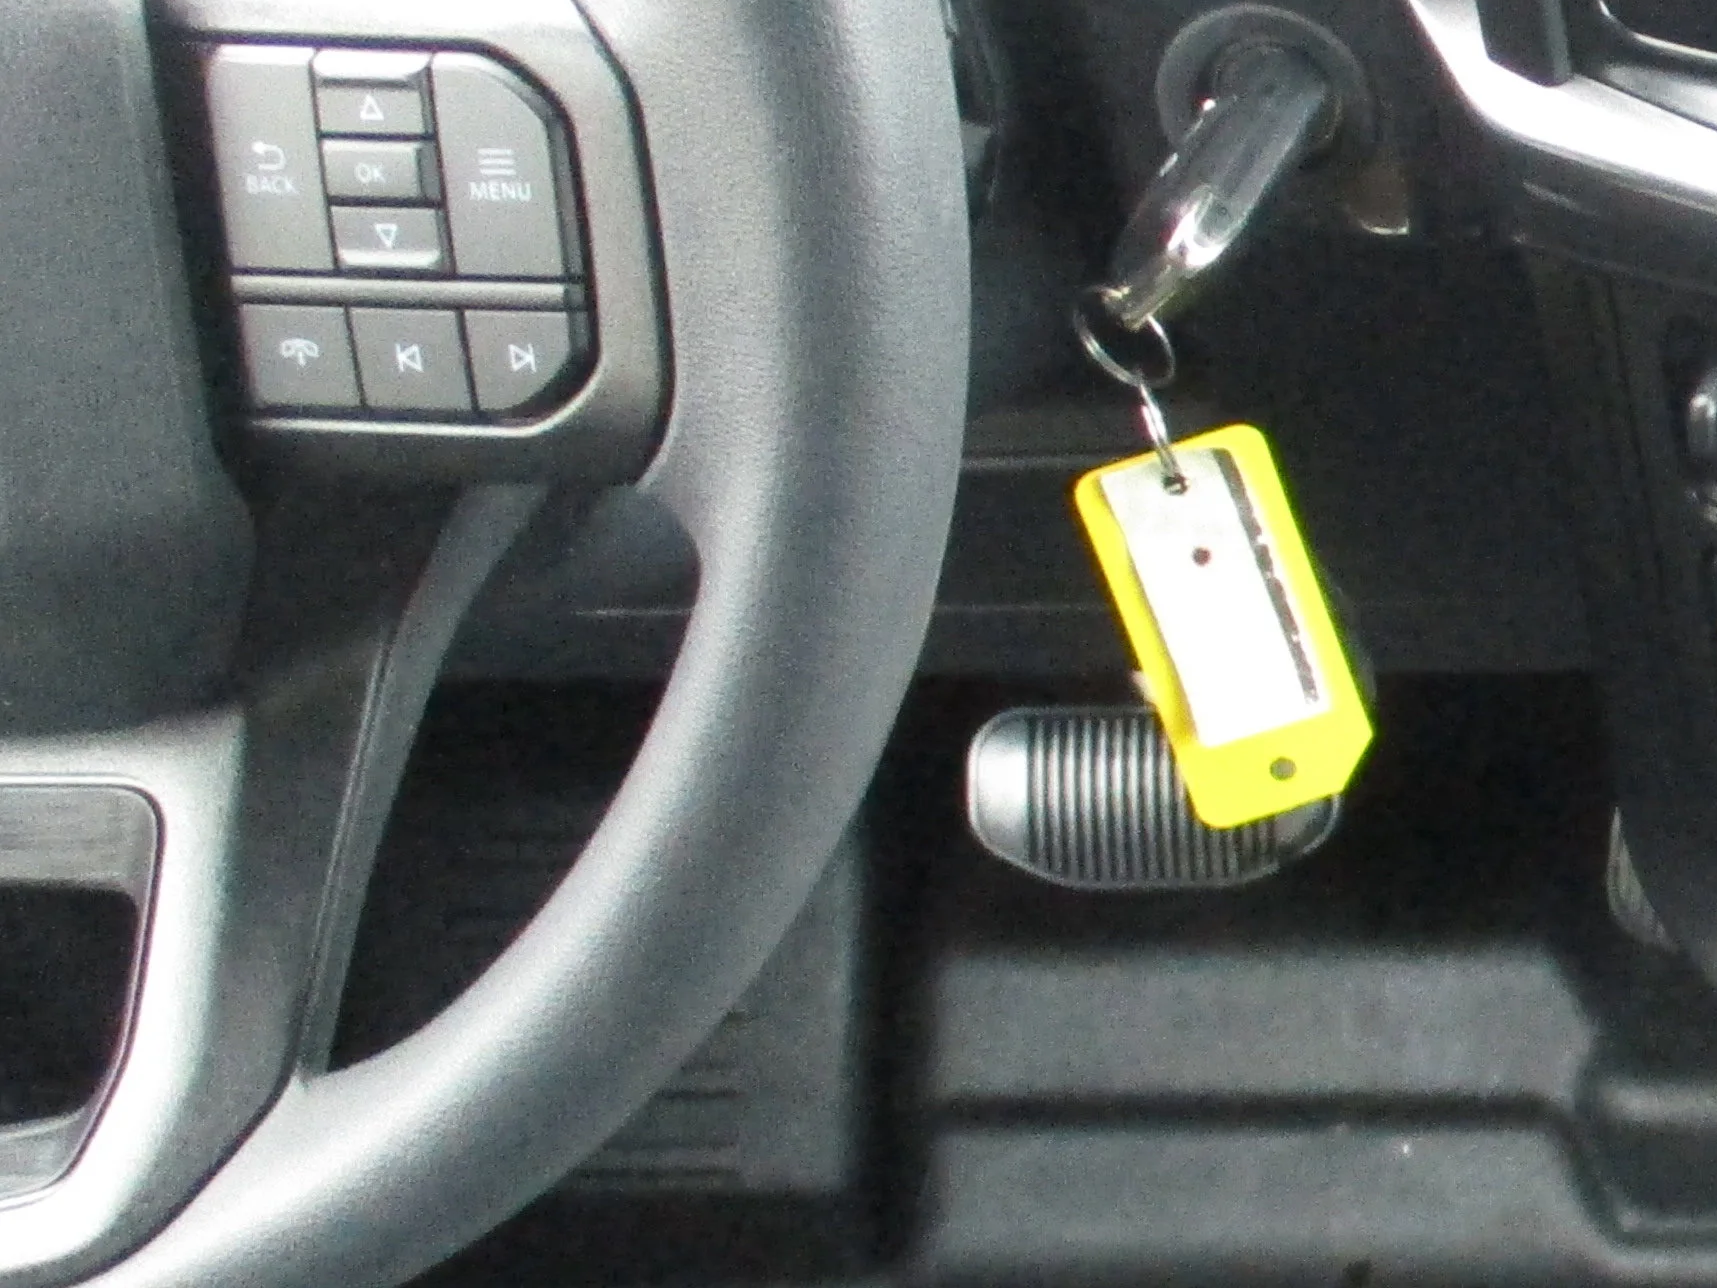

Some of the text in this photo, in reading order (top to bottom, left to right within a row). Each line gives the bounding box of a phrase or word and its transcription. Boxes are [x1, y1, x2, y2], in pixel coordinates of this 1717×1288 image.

[354, 163, 386, 184] OK
[245, 176, 298, 196] BACK
[468, 181, 533, 202] MENU
